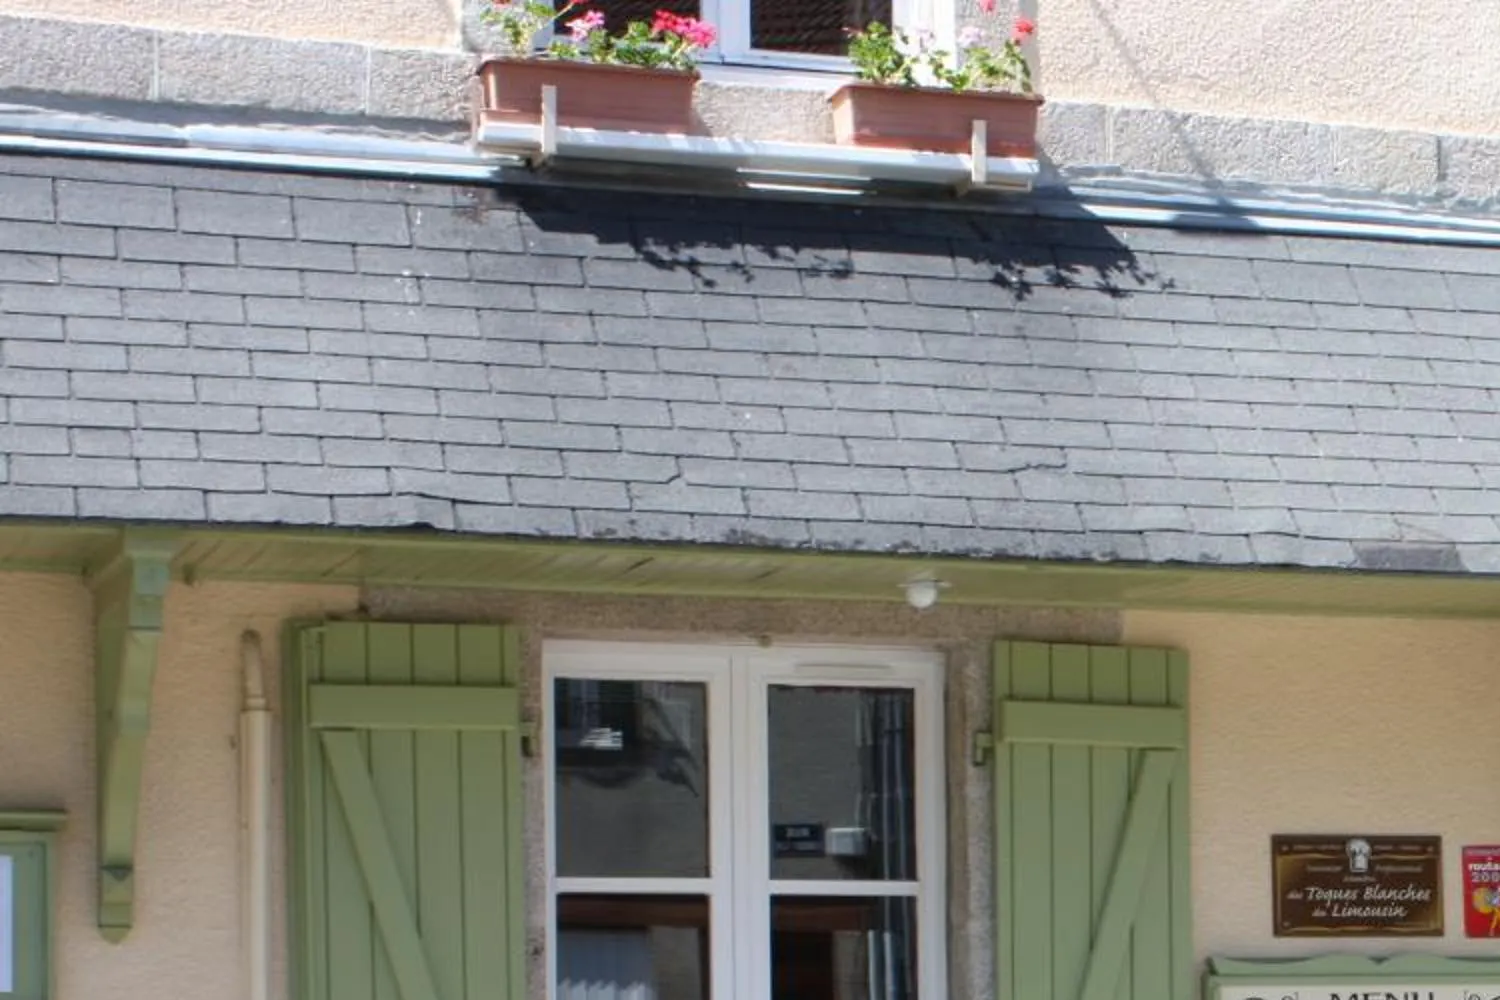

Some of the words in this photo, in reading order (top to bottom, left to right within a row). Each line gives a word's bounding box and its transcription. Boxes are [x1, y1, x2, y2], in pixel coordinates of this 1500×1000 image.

[1304, 886, 1360, 908] Toques
[1363, 883, 1432, 901] Blanches
[1331, 902, 1409, 918] Limousin
